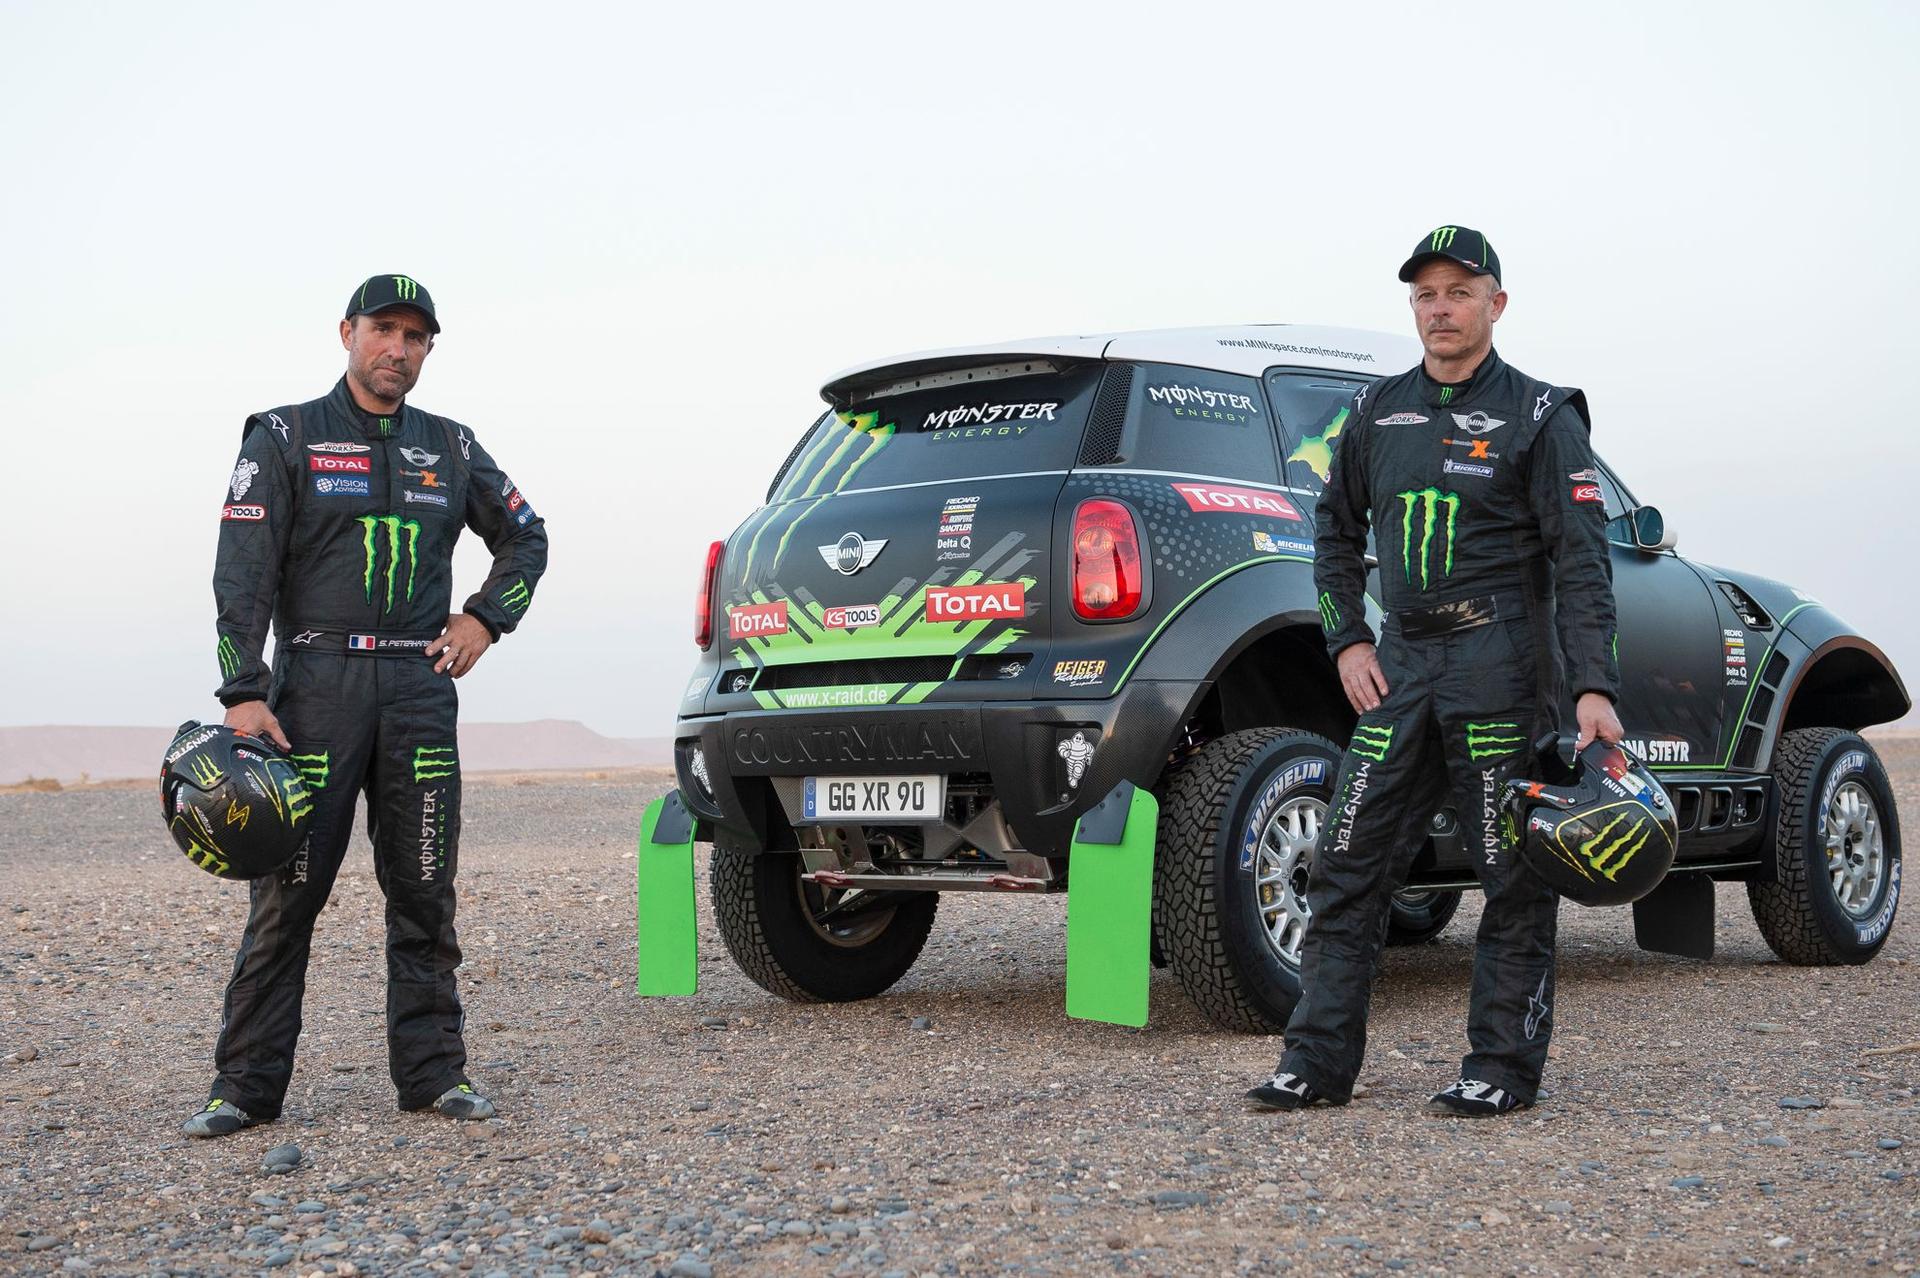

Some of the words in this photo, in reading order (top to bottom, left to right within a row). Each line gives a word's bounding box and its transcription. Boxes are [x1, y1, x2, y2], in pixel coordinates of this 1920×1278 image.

[1217, 338, 1375, 363] www.MINIspace.com/motorsport
[1174, 407, 1246, 423] ENERGY
[1390, 415, 1416, 424] WORKS
[1469, 420, 1486, 428] MINI
[932, 426, 1028, 441] ENERGY
[324, 444, 355, 452] WORKS
[313, 457, 369, 470] TOTAL
[1453, 464, 1491, 475] MICHELIN
[331, 477, 368, 488] VISION
[1181, 487, 1296, 514] TOTAL
[838, 546, 860, 559] MINI
[937, 538, 958, 549] Delta
[929, 591, 1021, 616] TOTAL
[731, 612, 785, 633] TOTAL
[786, 685, 888, 707] www.x-raid.de
[733, 720, 970, 764] COUNTRYMAN
[1648, 739, 1690, 763] STEYR
[1602, 777, 1627, 798] MINI
[1823, 755, 1864, 808] MICHELIN
[828, 782, 856, 812] GG
[862, 781, 890, 812] XR
[897, 781, 925, 811] 90
[1251, 762, 1322, 837] MICHELIN
[438, 803, 446, 868] ENERGY
[1860, 888, 1900, 943] MICHELIN
